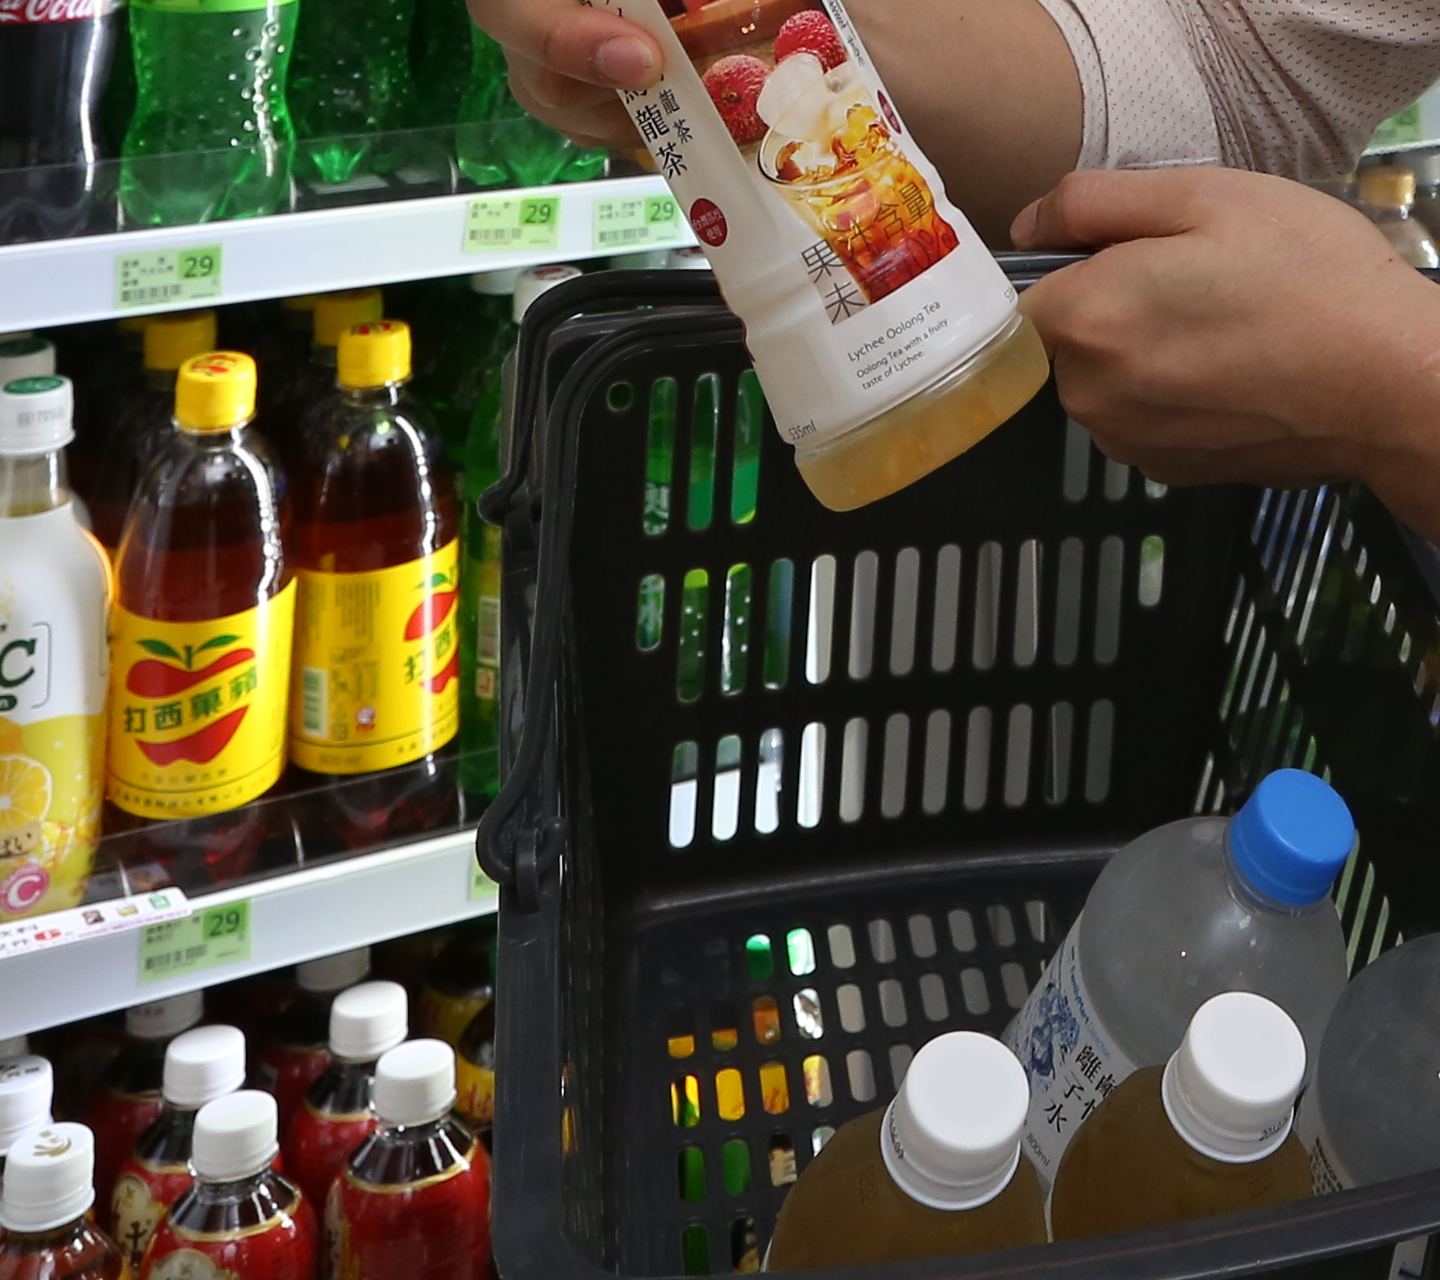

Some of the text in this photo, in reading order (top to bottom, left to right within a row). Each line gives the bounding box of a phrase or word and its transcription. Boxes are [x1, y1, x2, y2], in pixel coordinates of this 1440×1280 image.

[524, 201, 553, 226] 29
[650, 201, 675, 221] 29
[800, 180, 931, 285] 果汁含量
[182, 255, 214, 278] 29
[847, 299, 941, 362] Lychee Oolong Tea
[856, 356, 888, 379] Oolong
[887, 345, 904, 359] Tea
[904, 335, 923, 349] with
[928, 317, 949, 337] fruity
[862, 374, 883, 391] taste
[788, 419, 818, 441] 535ml
[209, 911, 242, 937] 29
[1043, 1043, 1103, 1134] 離子水
[1026, 1132, 1051, 1168] 800ml
